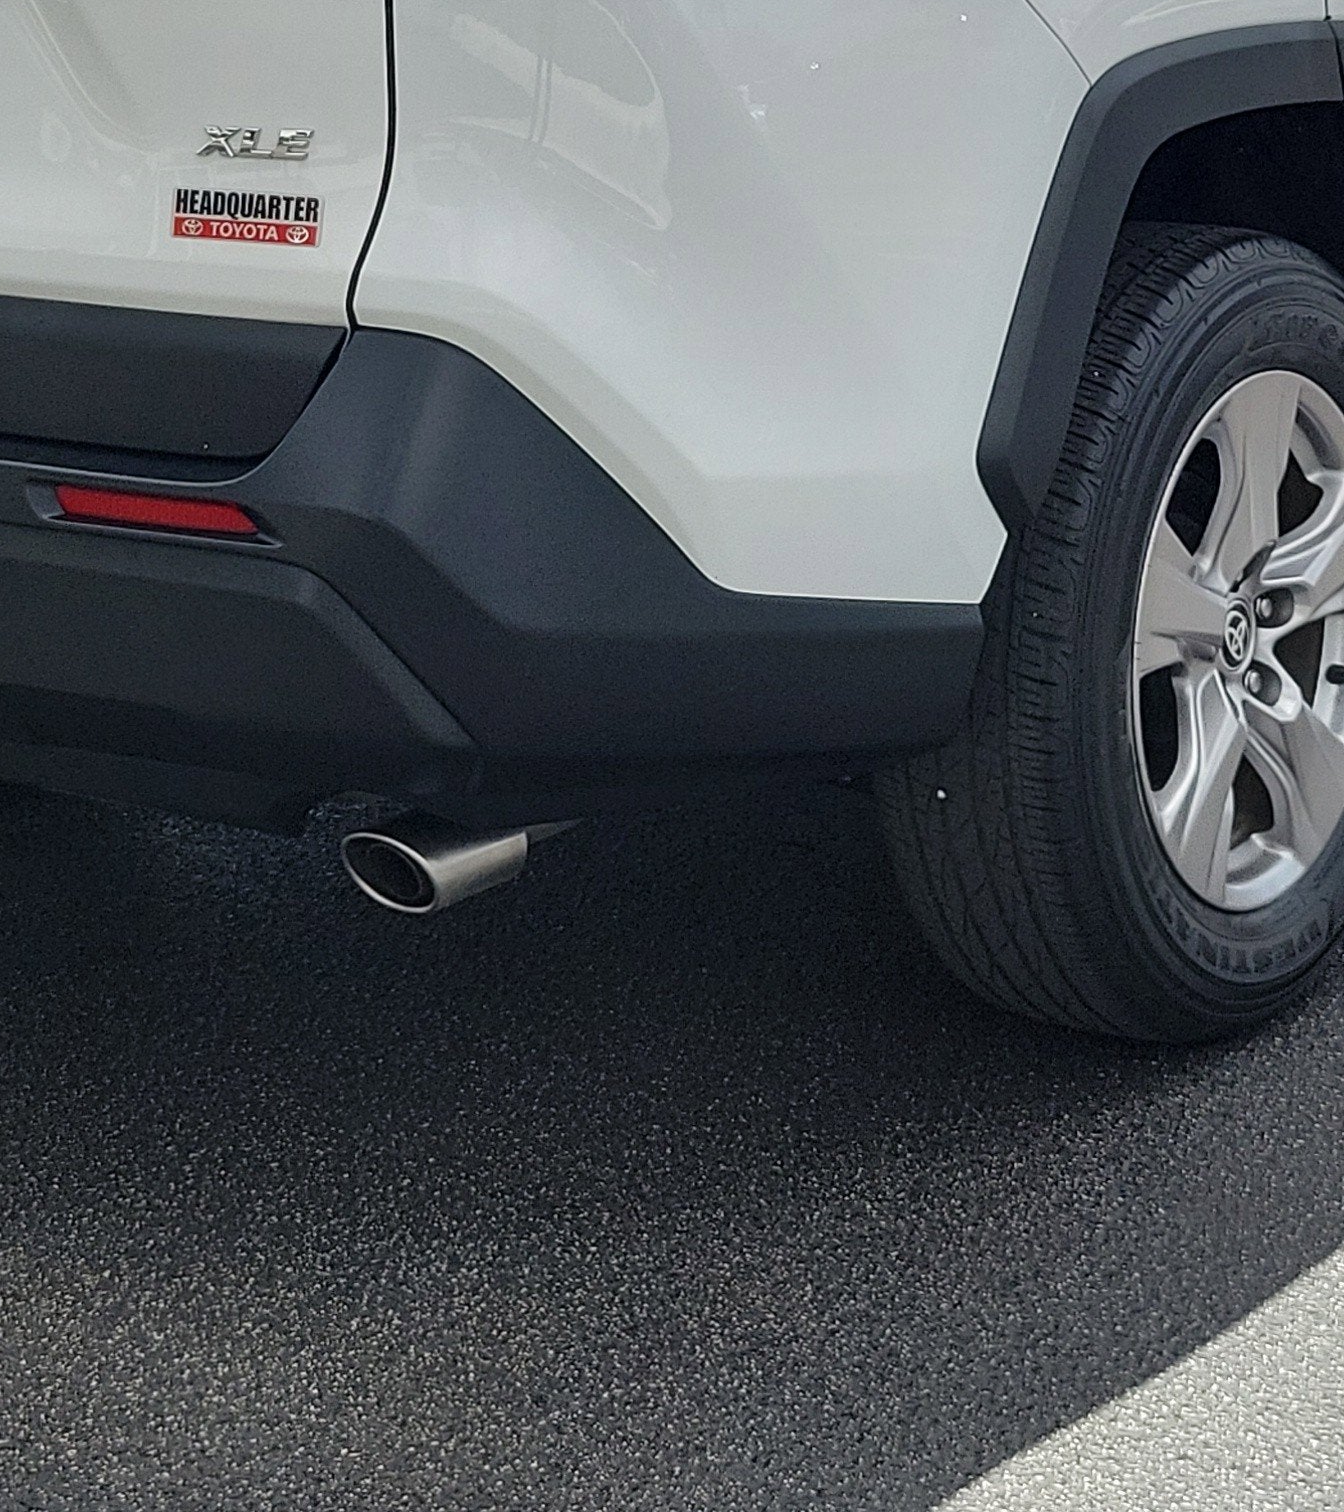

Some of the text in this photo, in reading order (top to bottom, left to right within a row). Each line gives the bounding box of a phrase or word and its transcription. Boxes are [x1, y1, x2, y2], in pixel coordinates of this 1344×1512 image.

[196, 126, 314, 161] XLE
[175, 188, 320, 223] HEADQUARTER
[210, 221, 279, 241] TOYOTA
